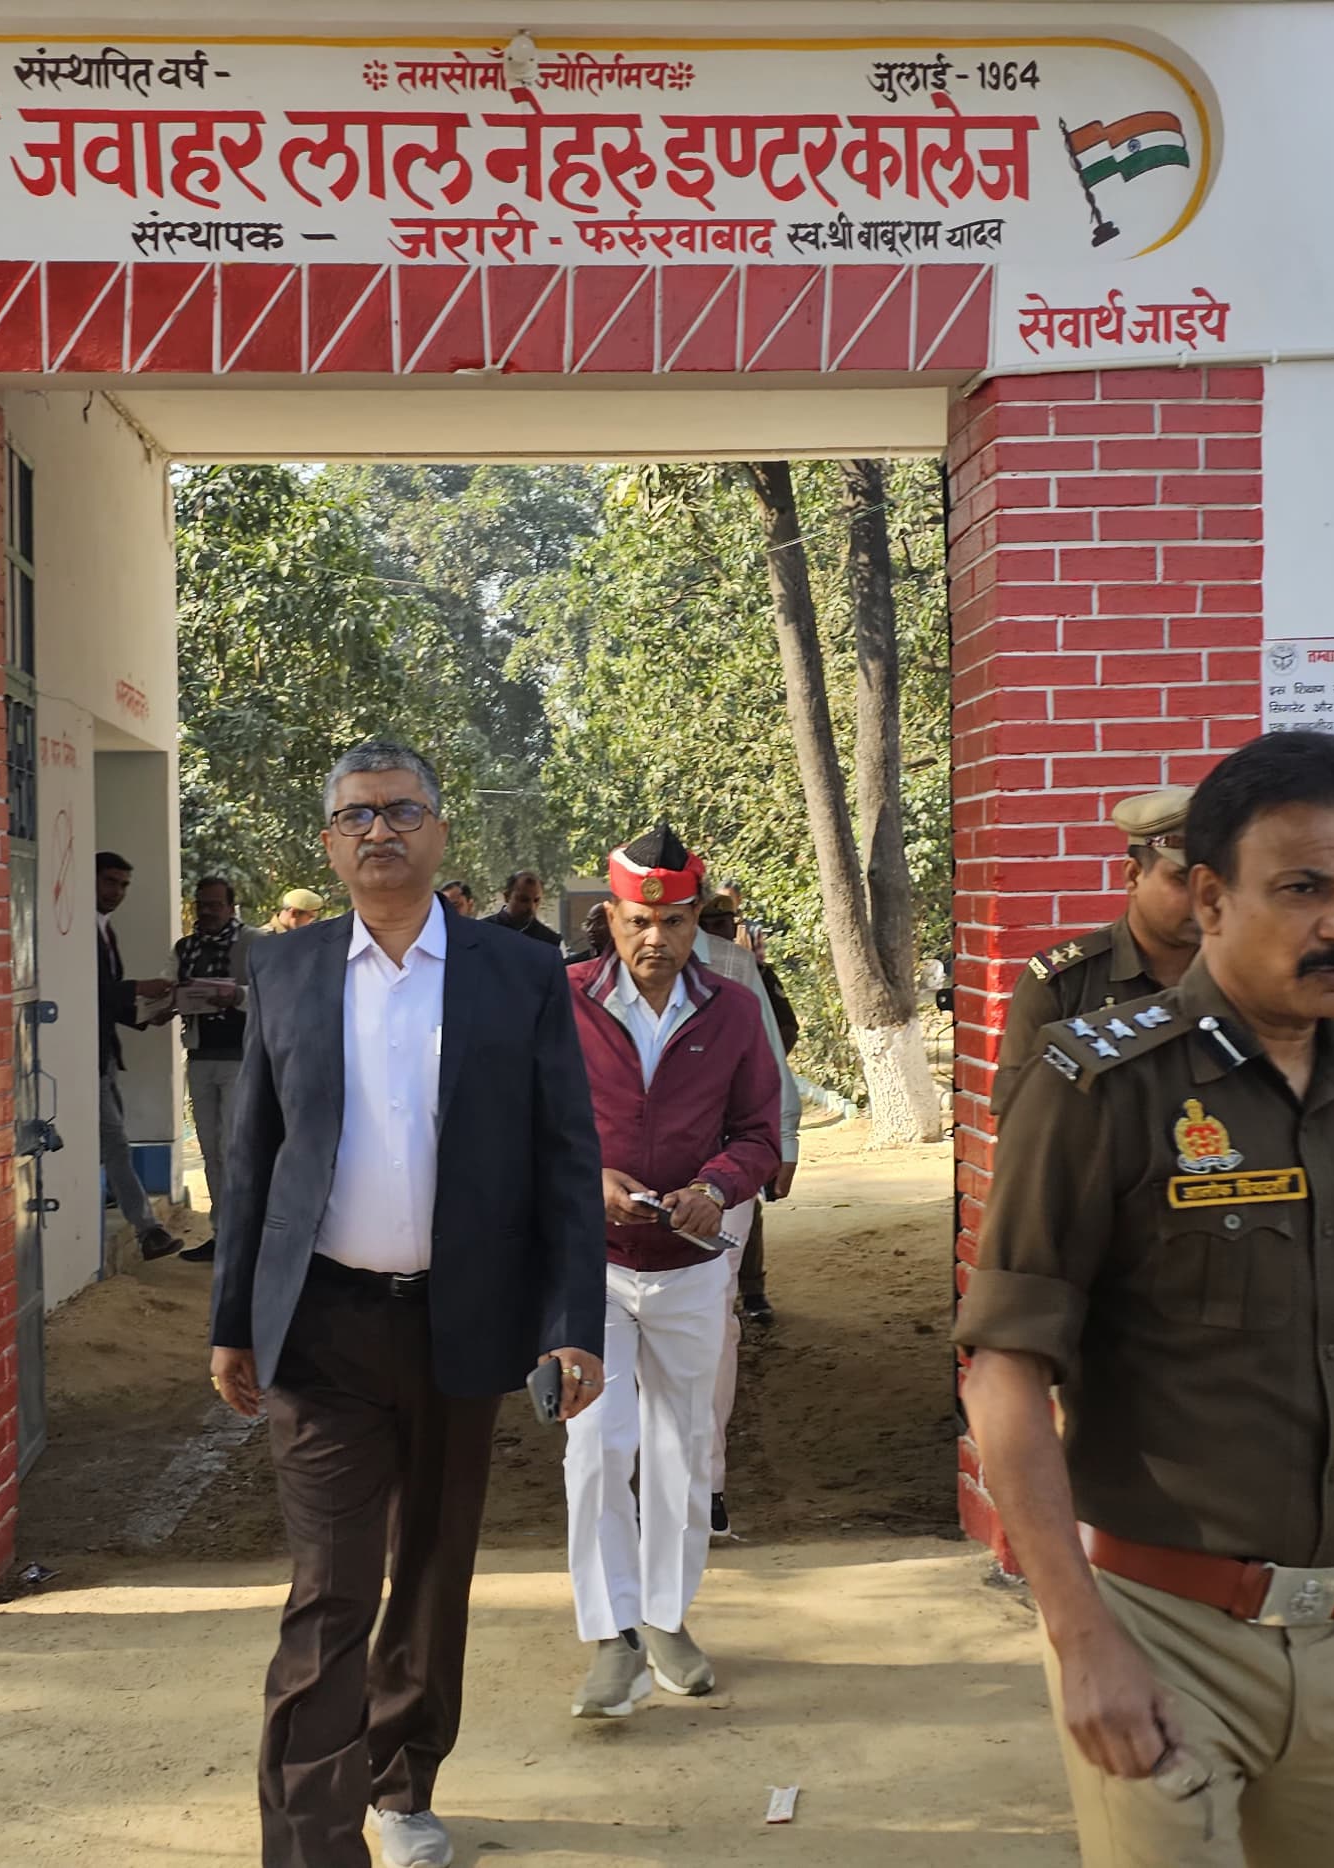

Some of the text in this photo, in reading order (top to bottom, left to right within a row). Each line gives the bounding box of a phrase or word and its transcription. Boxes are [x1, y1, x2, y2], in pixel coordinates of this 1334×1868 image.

[13, 46, 154, 98] संस्थापित
[157, 49, 210, 90] वर्ष
[534, 51, 670, 98] ज्योतिर्गमय
[865, 52, 955, 103] जुलाई
[976, 59, 1041, 91] 1964
[9, 107, 268, 210] जवाहर
[278, 109, 474, 211] लाल
[131, 210, 285, 257] संस्थापक
[387, 203, 540, 264] जरारी
[945, 218, 1008, 251] यादव
